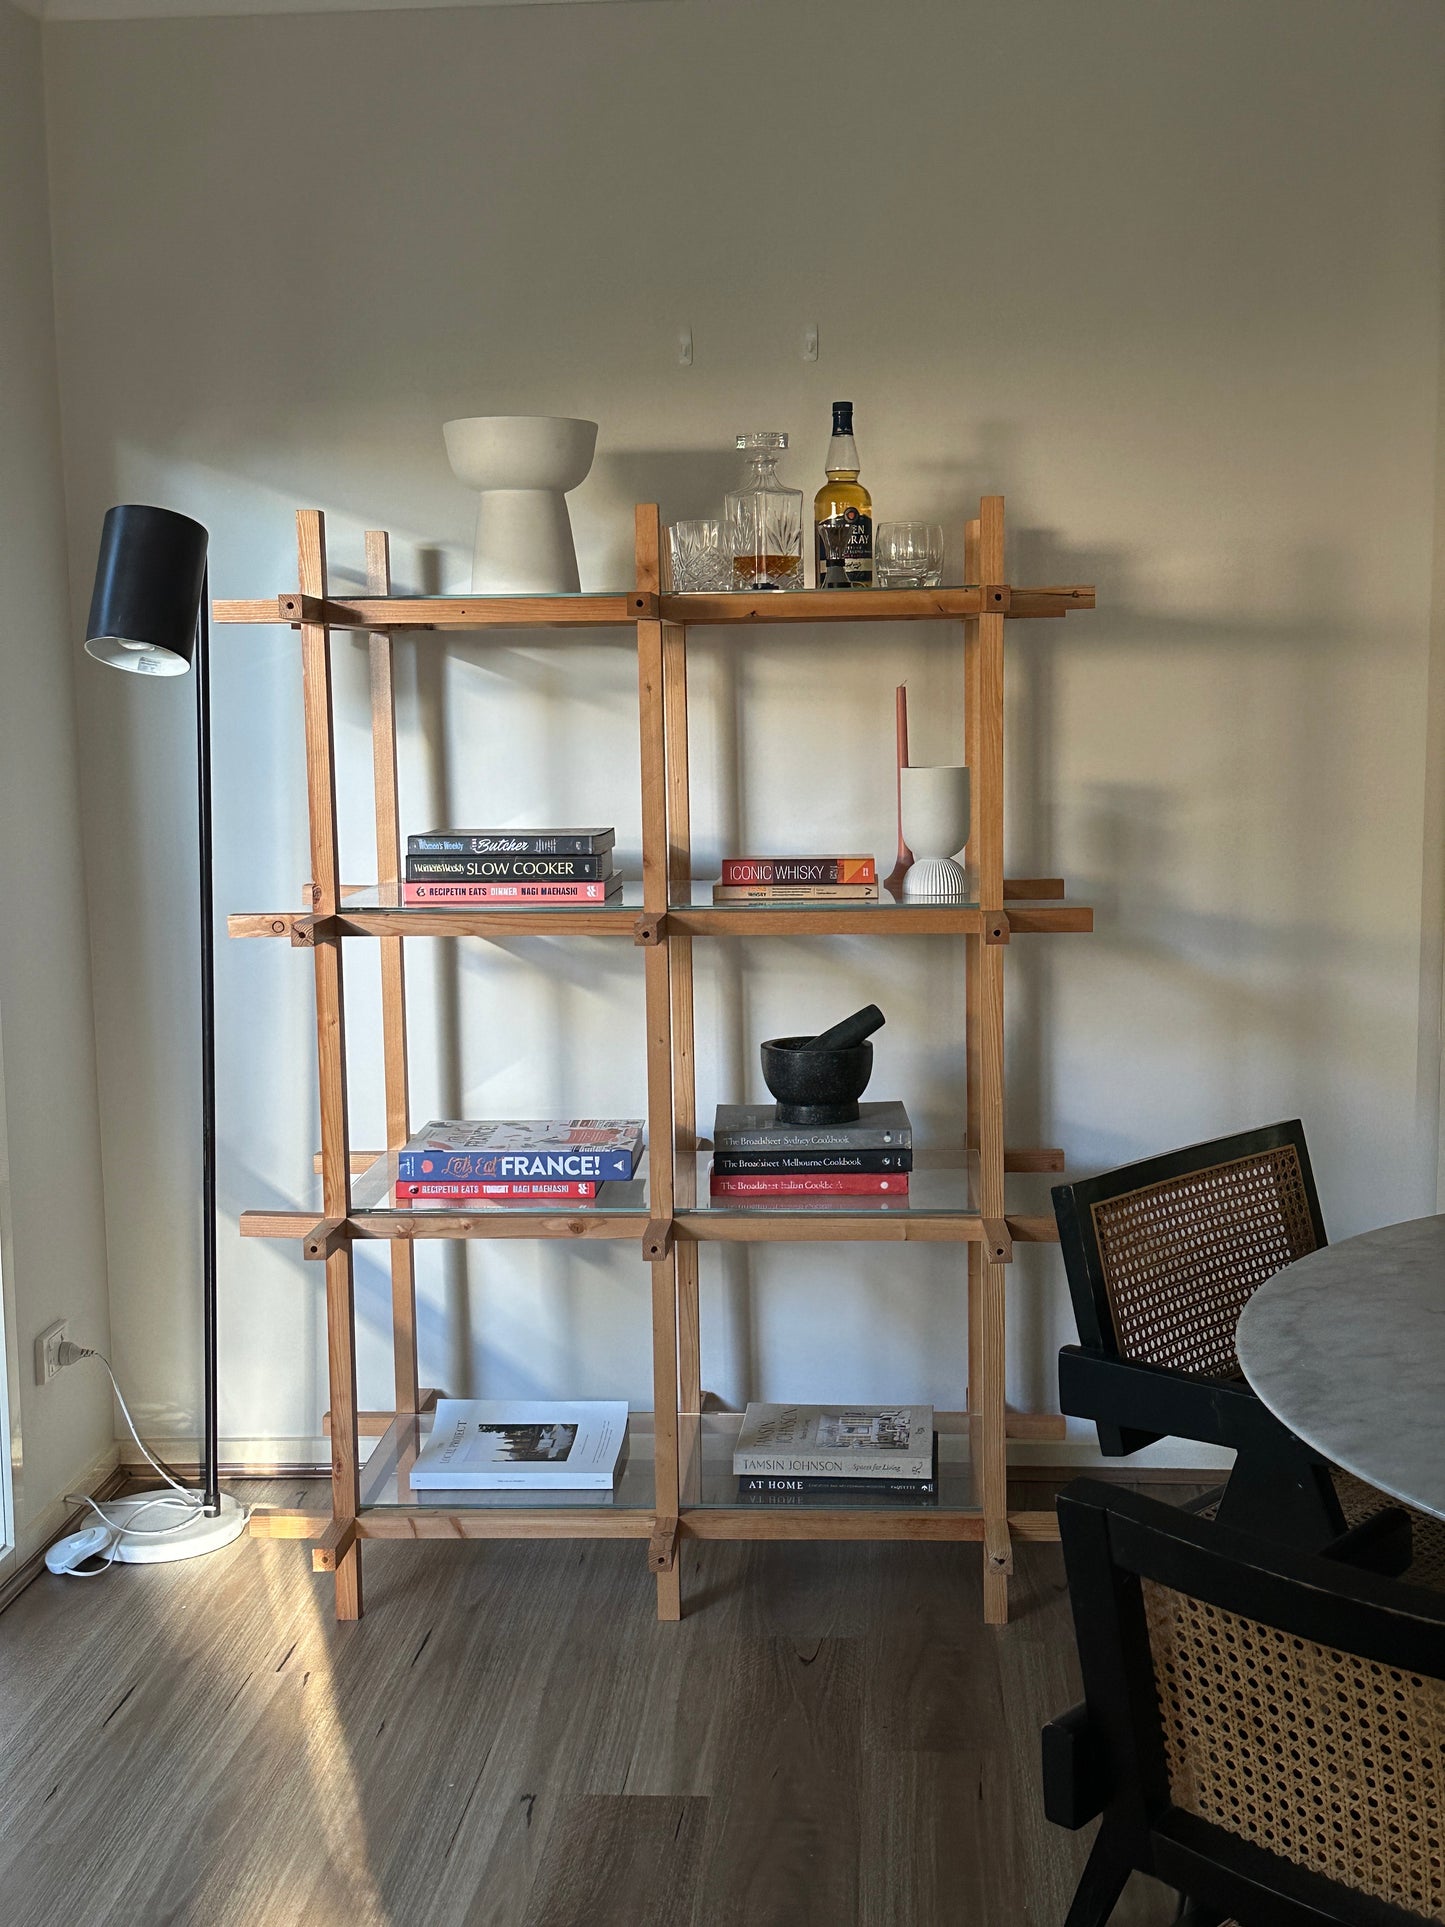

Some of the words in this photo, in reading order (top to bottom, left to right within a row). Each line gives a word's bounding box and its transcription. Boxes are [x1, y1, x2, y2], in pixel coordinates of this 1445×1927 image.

[474, 838, 529, 854] Butcher
[466, 862, 510, 876] SLOW
[513, 862, 574, 876] COOKER
[729, 865, 772, 881] ICONIC
[774, 865, 824, 880] WHISKY
[429, 887, 467, 896] RECIPETIN
[468, 887, 487, 896] EATS
[521, 887, 539, 896] NAGI
[723, 1137, 739, 1146] The
[740, 1136, 781, 1145] Broadsheet
[783, 1136, 811, 1147] Sydney
[811, 1135, 850, 1145] Cookbook
[501, 1156, 600, 1176] FRANCE!
[722, 1159, 738, 1168] The
[739, 1159, 779, 1168] Broadsheet
[782, 1158, 822, 1168] Melbourne
[823, 1157, 862, 1167] Cookbook
[461, 1185, 479, 1194] EATS
[720, 1181, 736, 1190] The
[743, 1459, 785, 1471] TAMSIN
[788, 1460, 843, 1472] JOHNSON
[749, 1480, 765, 1490] AT
[768, 1481, 804, 1491] HOME
